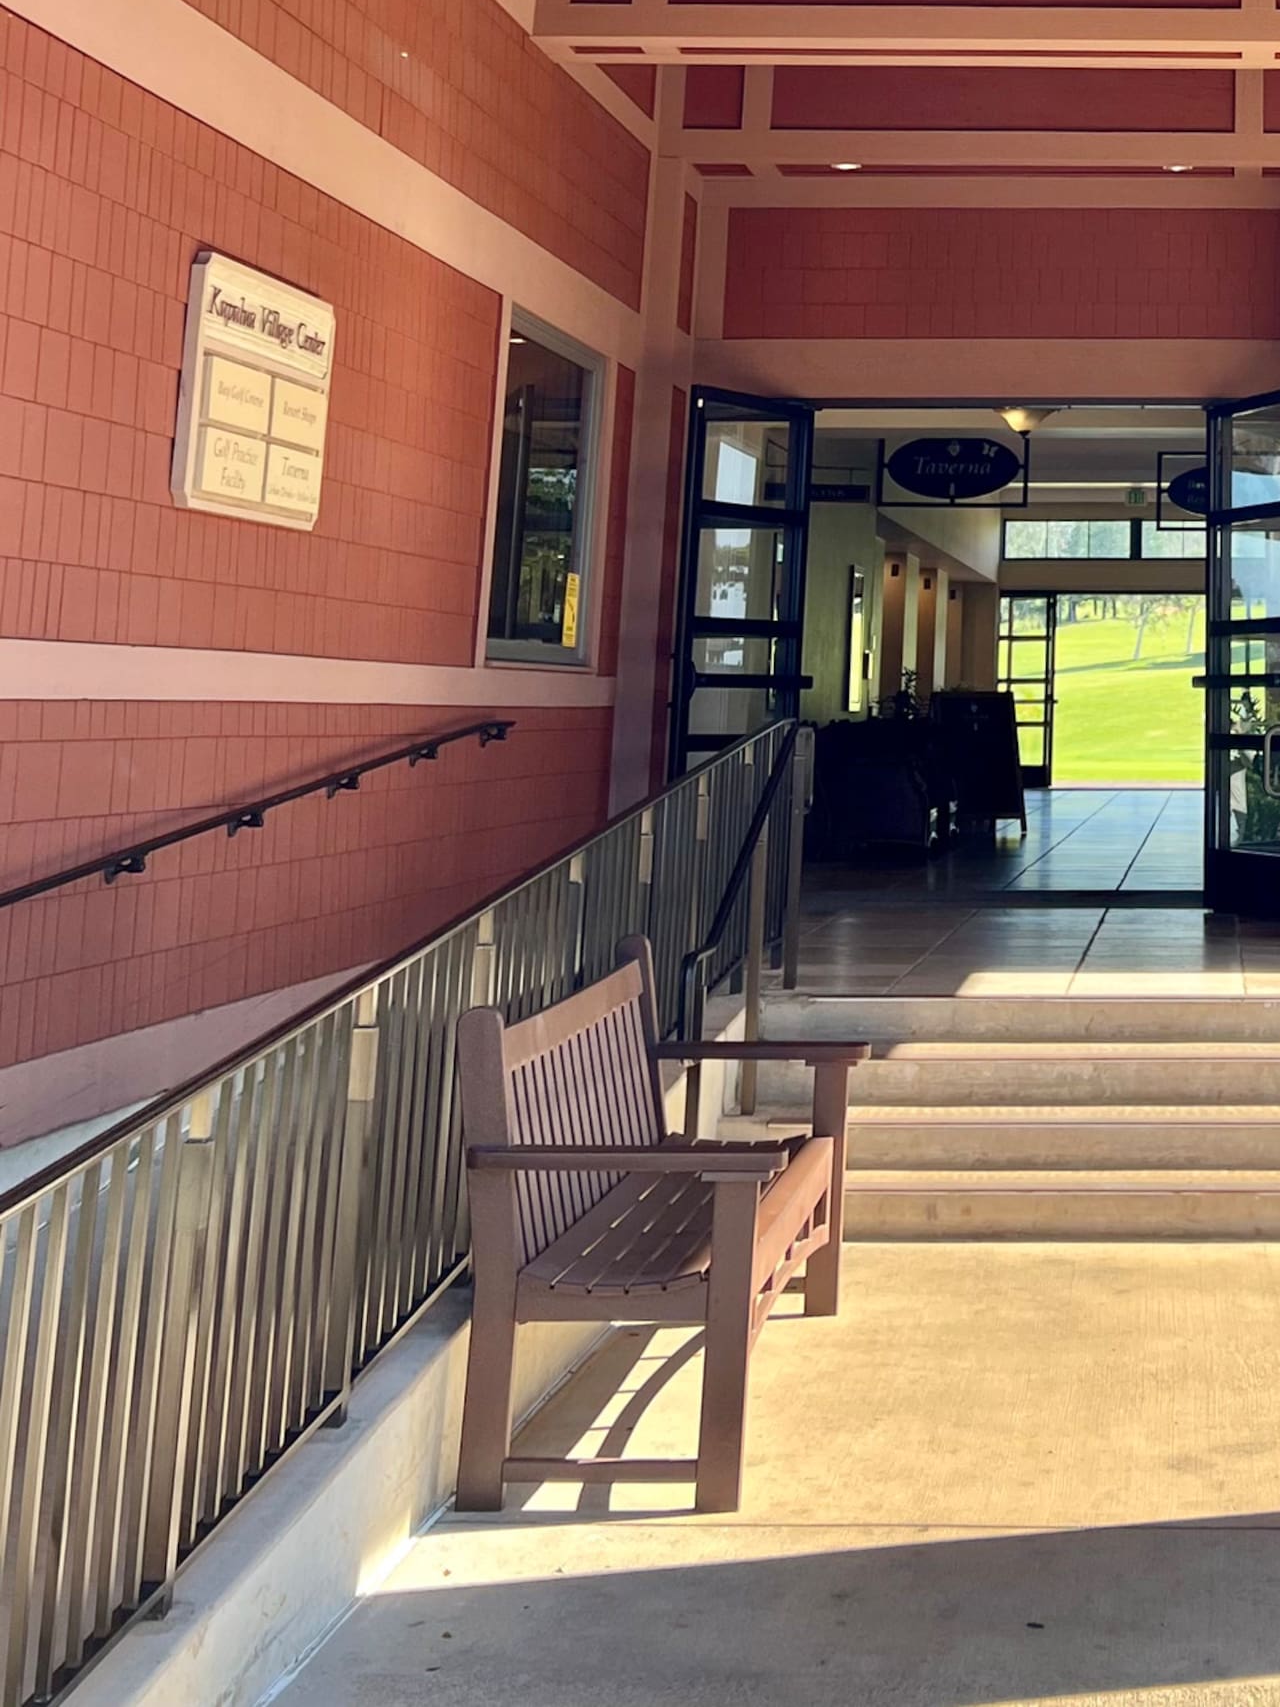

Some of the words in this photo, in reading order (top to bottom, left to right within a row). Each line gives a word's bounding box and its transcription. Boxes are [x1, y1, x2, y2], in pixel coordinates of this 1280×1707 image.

[206, 285, 257, 329] Kapalua
[260, 305, 295, 349] Village
[296, 322, 326, 356] Center
[913, 454, 992, 477] Taverna
